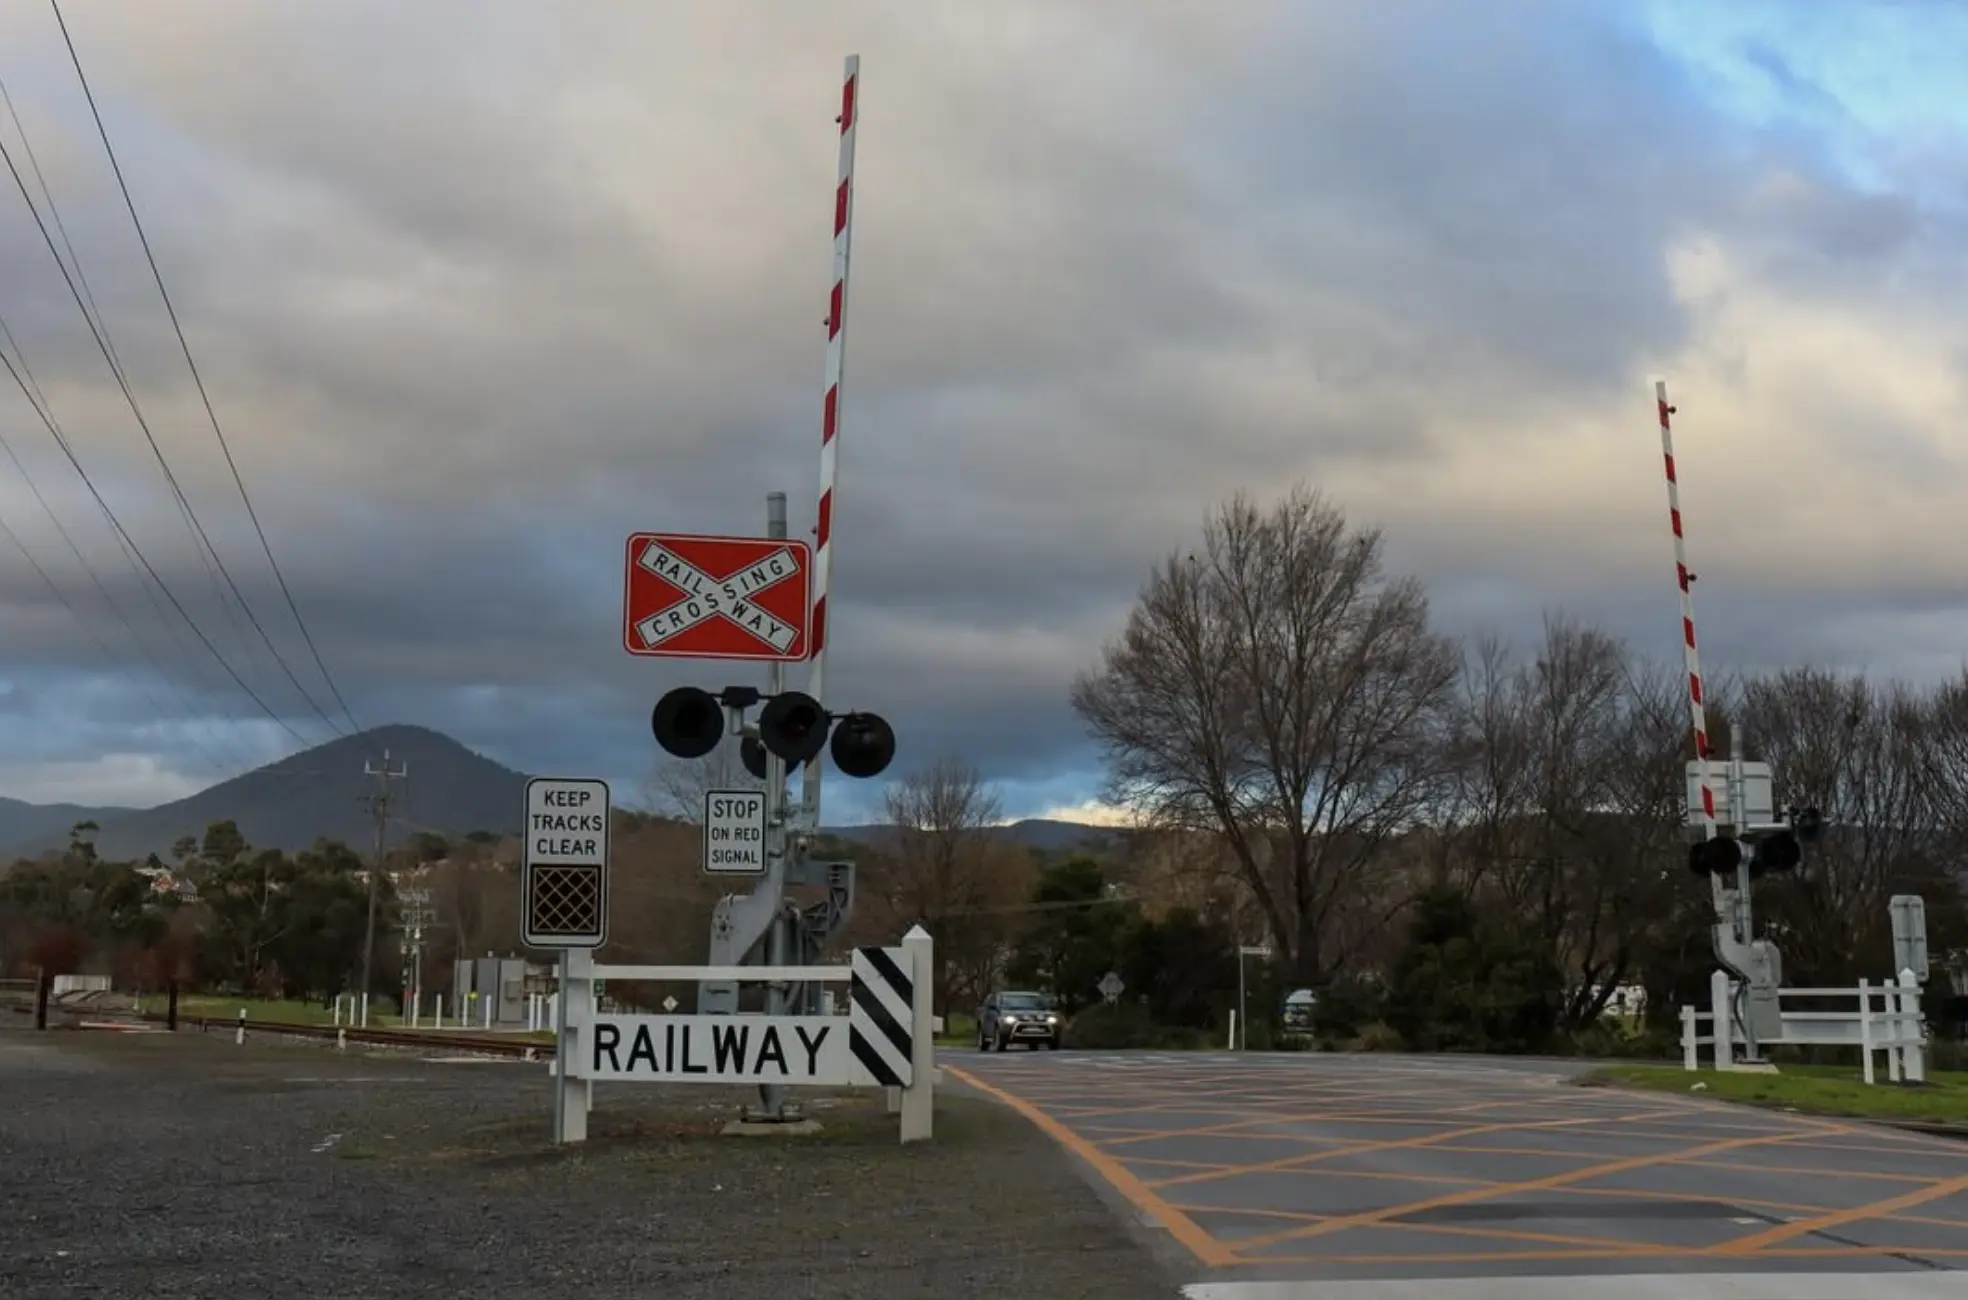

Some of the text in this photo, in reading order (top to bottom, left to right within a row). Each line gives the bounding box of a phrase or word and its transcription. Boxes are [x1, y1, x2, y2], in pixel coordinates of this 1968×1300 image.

[652, 560, 783, 635] CROSSING
[544, 791, 590, 807] KEEP
[714, 800, 758, 818] STOP
[532, 814, 603, 831] TRACKS
[711, 826, 760, 840] ON RED
[537, 839, 596, 855] CLEAR
[712, 850, 758, 864] SIGNAL
[593, 1023, 831, 1076] RAILWAY
